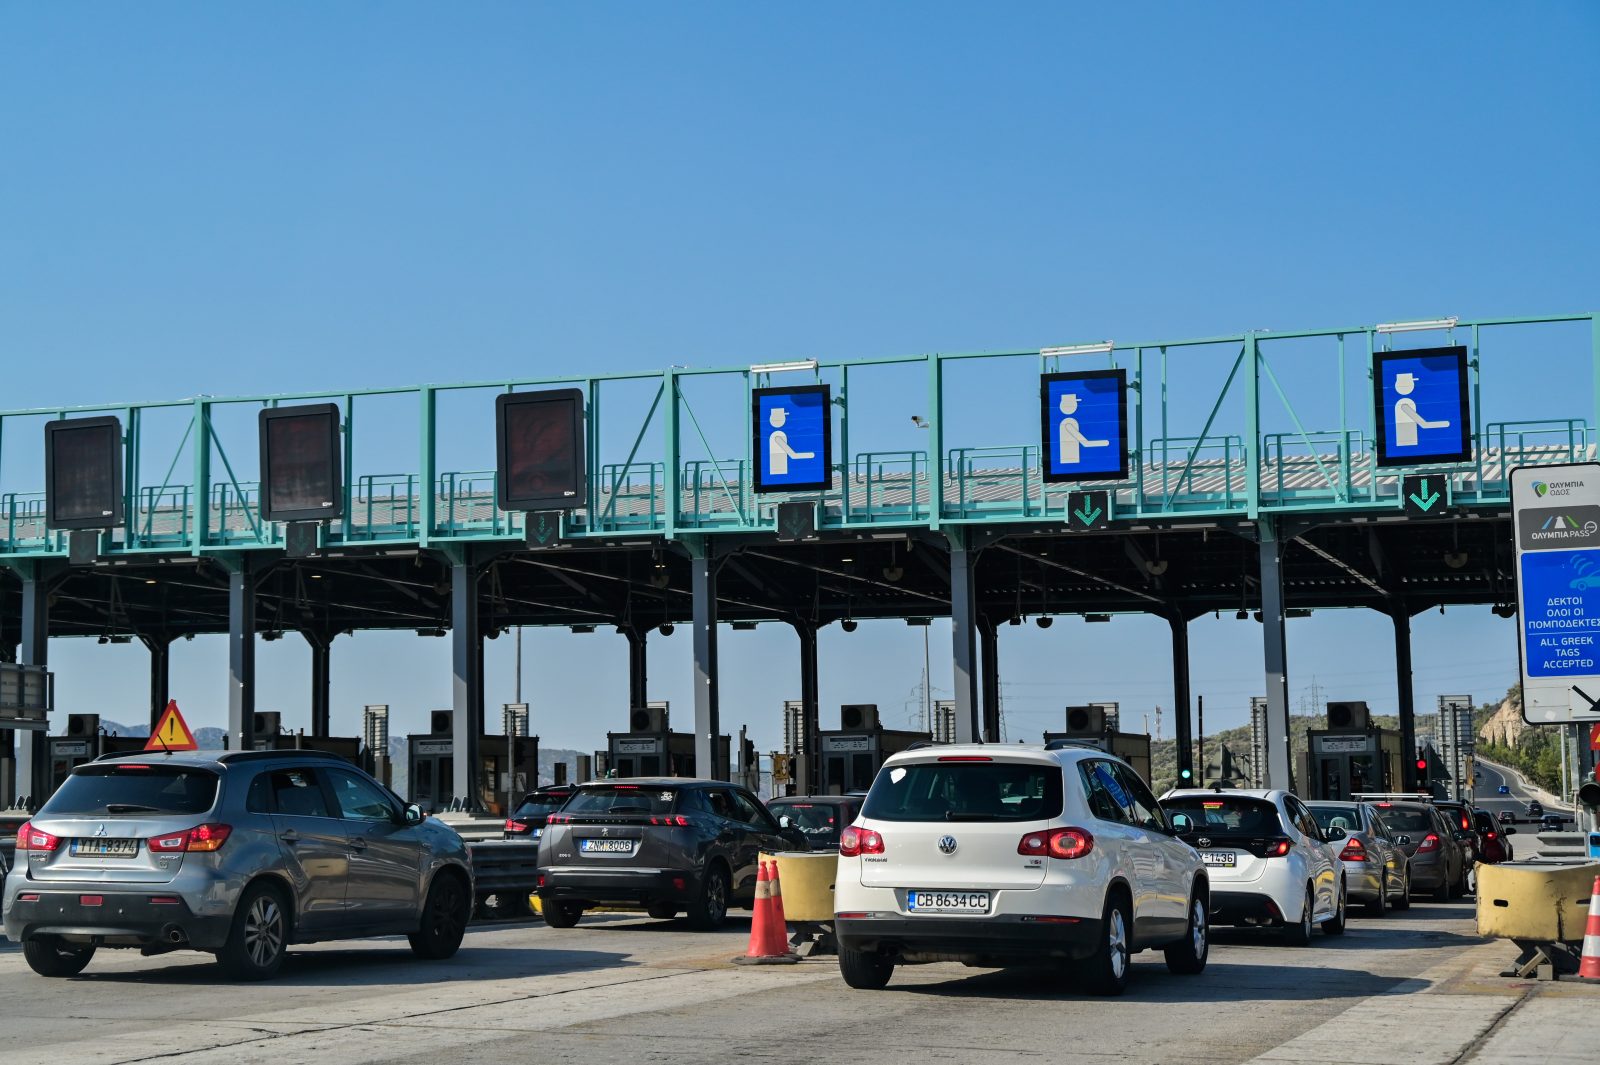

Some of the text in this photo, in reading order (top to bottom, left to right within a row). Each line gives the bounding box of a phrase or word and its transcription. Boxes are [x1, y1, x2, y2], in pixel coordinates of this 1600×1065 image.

[1549, 480, 1585, 489] ΟΛΥΜΠΙΑ
[1531, 529, 1590, 540] ΟΛΥΜΠΙΑ PASS
[1547, 596, 1582, 607] ΔΕΚΤΟΙ
[1546, 607, 1584, 617] ΟΛΟΙ ΟΙ
[1540, 636, 1594, 647] ALL GREEK
[1555, 648, 1580, 657] TAGS
[1543, 659, 1594, 670] ACCEPTED
[917, 893, 987, 908] CB 8634 CC
